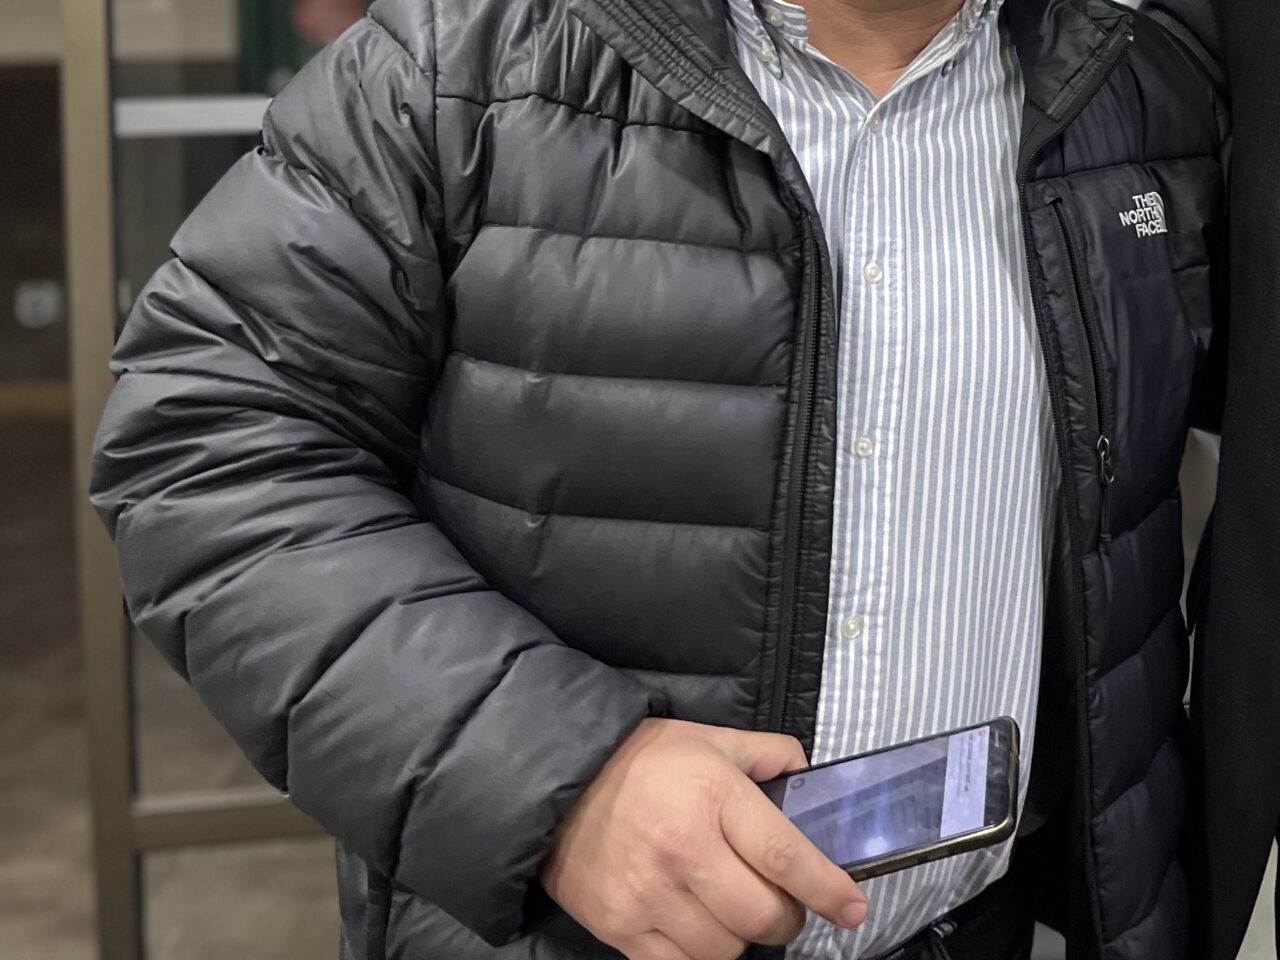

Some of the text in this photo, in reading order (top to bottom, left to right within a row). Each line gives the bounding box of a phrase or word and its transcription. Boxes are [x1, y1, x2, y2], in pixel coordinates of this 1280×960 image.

[1132, 192, 1156, 209] THE
[1118, 207, 1161, 227] NORTH
[1135, 219, 1165, 239] FACE
